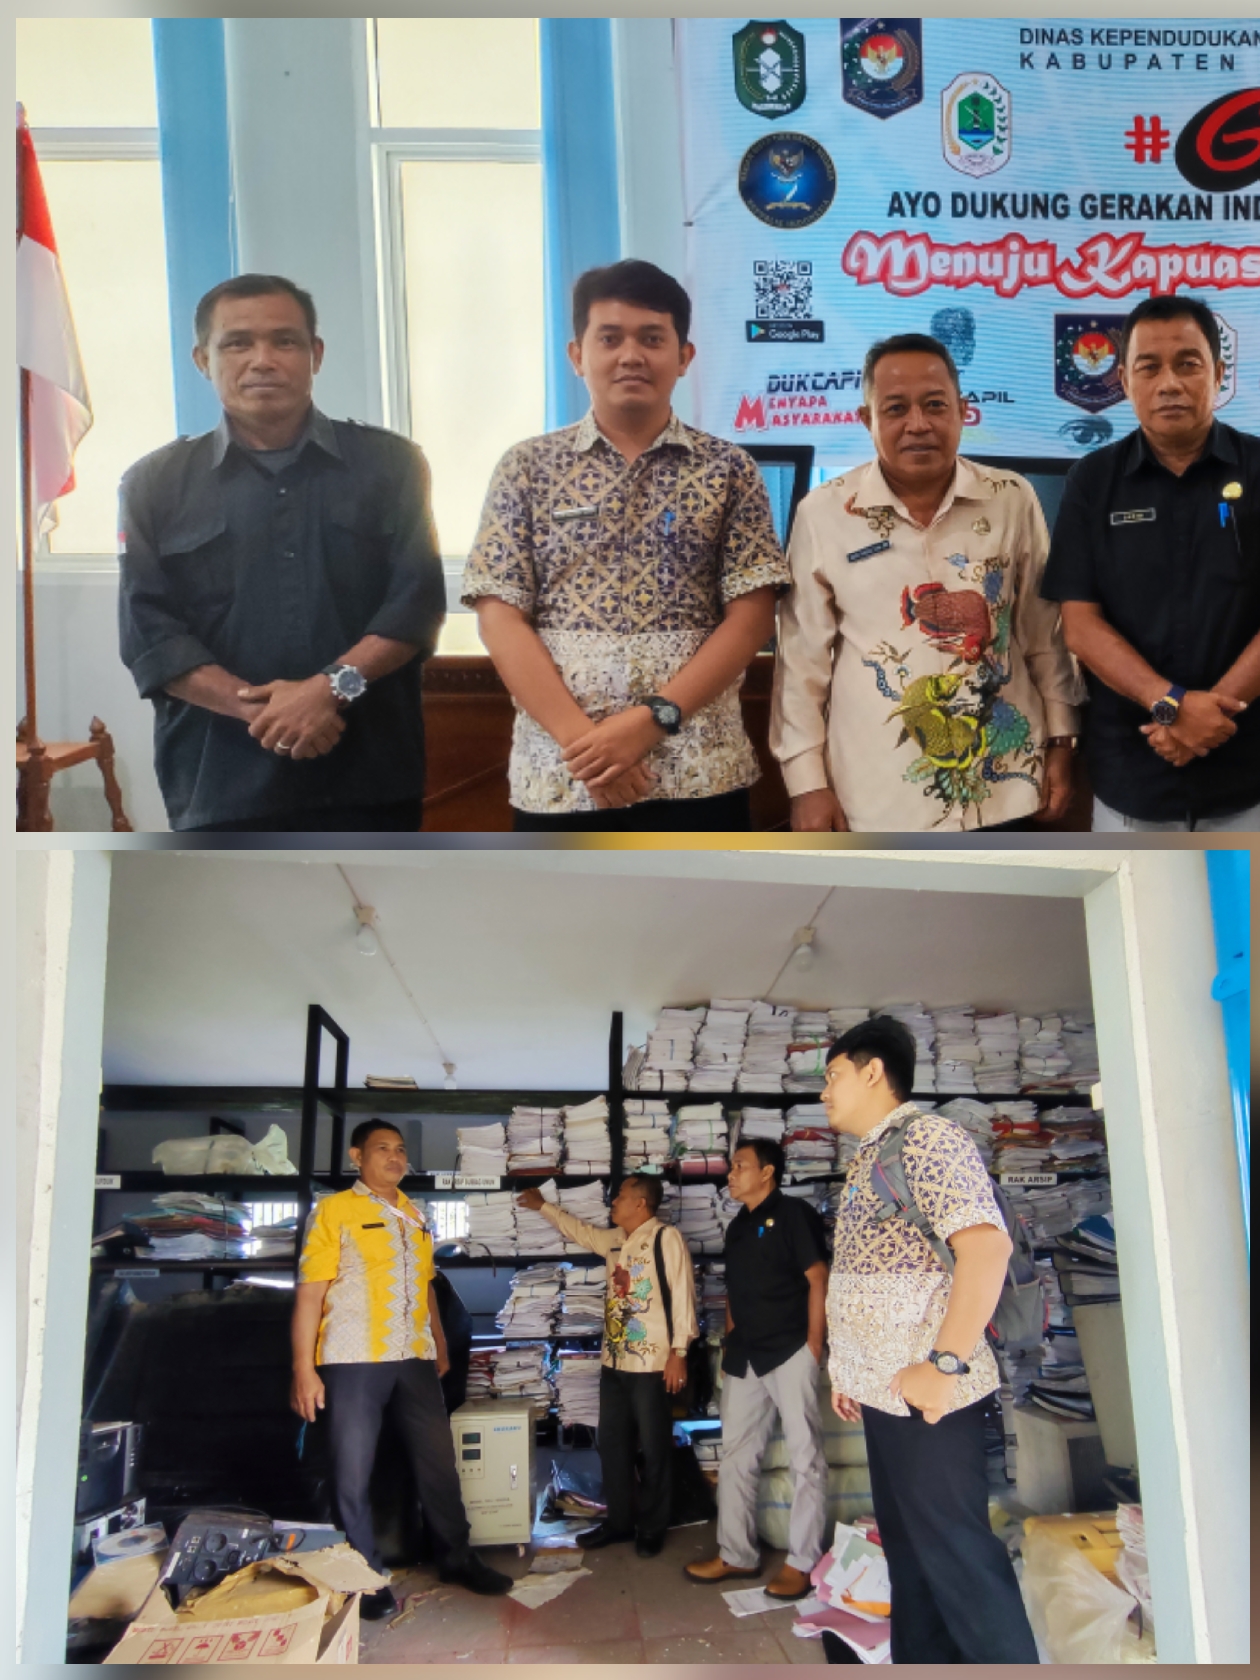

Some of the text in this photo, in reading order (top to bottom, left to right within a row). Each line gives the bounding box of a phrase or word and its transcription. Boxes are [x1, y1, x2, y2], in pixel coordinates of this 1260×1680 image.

[1019, 28, 1084, 46] DINAS
[1020, 52, 1235, 70] KABUPATEN
[887, 191, 942, 219] AYO
[950, 192, 1070, 220] DUKUNG
[1079, 193, 1213, 221] GERAKAN
[846, 234, 1053, 295] Menuju
[769, 328, 800, 341] Google
[767, 370, 862, 394] DUKCAPI
[1008, 1176, 1053, 1184] RAK ARSIP
